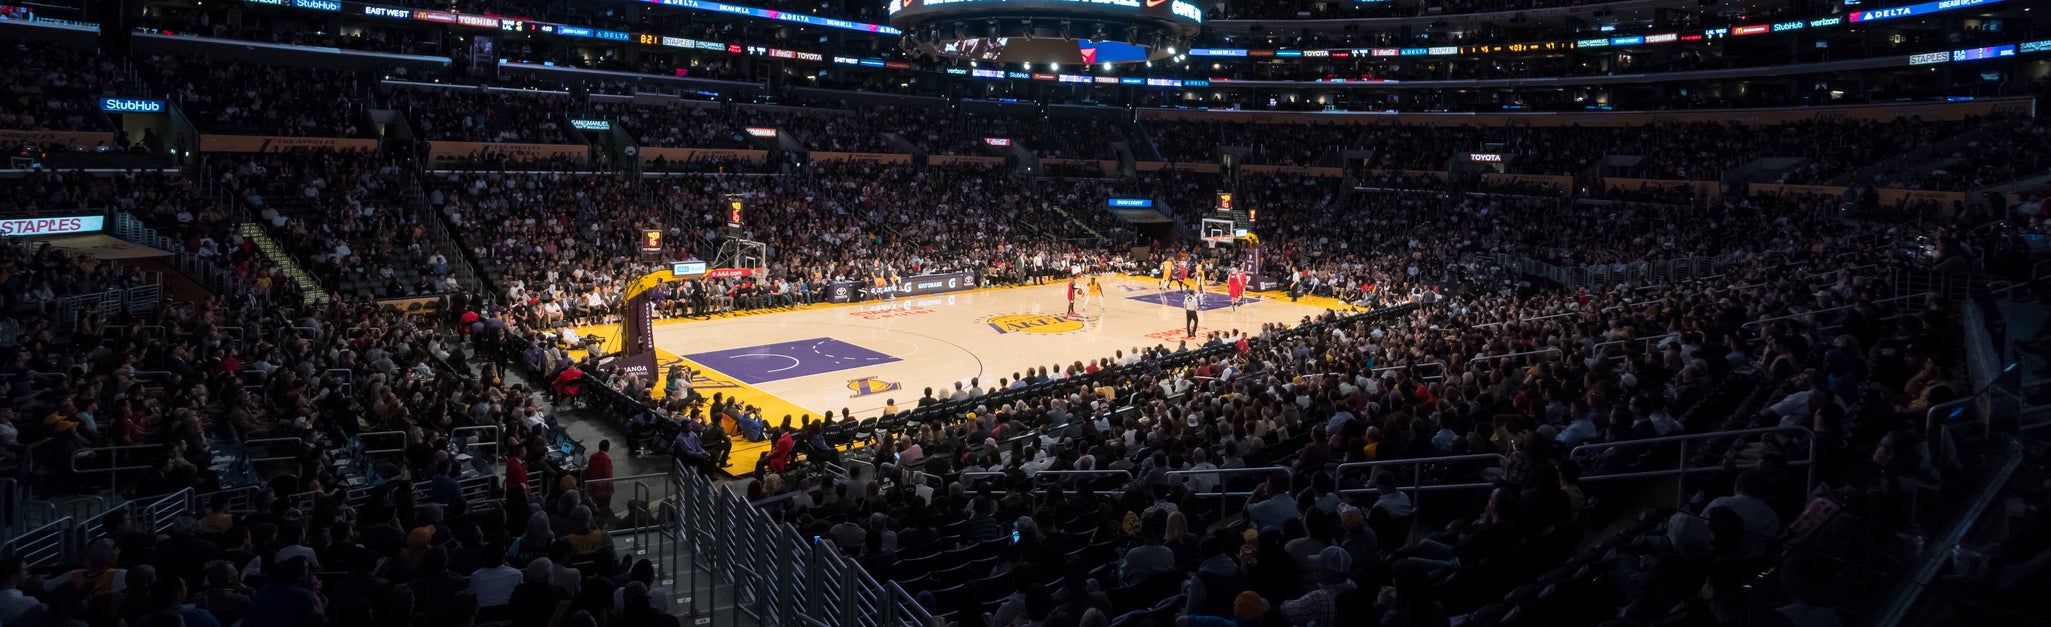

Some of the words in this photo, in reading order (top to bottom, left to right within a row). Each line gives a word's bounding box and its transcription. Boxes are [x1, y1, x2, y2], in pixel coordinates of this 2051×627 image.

[296, 0, 337, 10] StubHub
[365, 6, 386, 16] EAST
[386, 8, 409, 18] WEST
[1875, 8, 1910, 18] DELTA
[460, 16, 498, 26] TOSHIBA
[1774, 20, 1803, 31] StubHub
[1810, 18, 1839, 27] verizon
[604, 32, 628, 40] DELTA
[1645, 34, 1676, 42] TOSHIBA
[663, 37, 694, 48] STAPLES
[796, 52, 822, 60] TOYOTA
[1911, 52, 1948, 64] STAPLES
[106, 100, 160, 111] StubHub
[1470, 154, 1501, 162] TOYOTA
[2, 218, 81, 234] STAPLES
[904, 282, 912, 292] G
[948, 278, 956, 288] G
